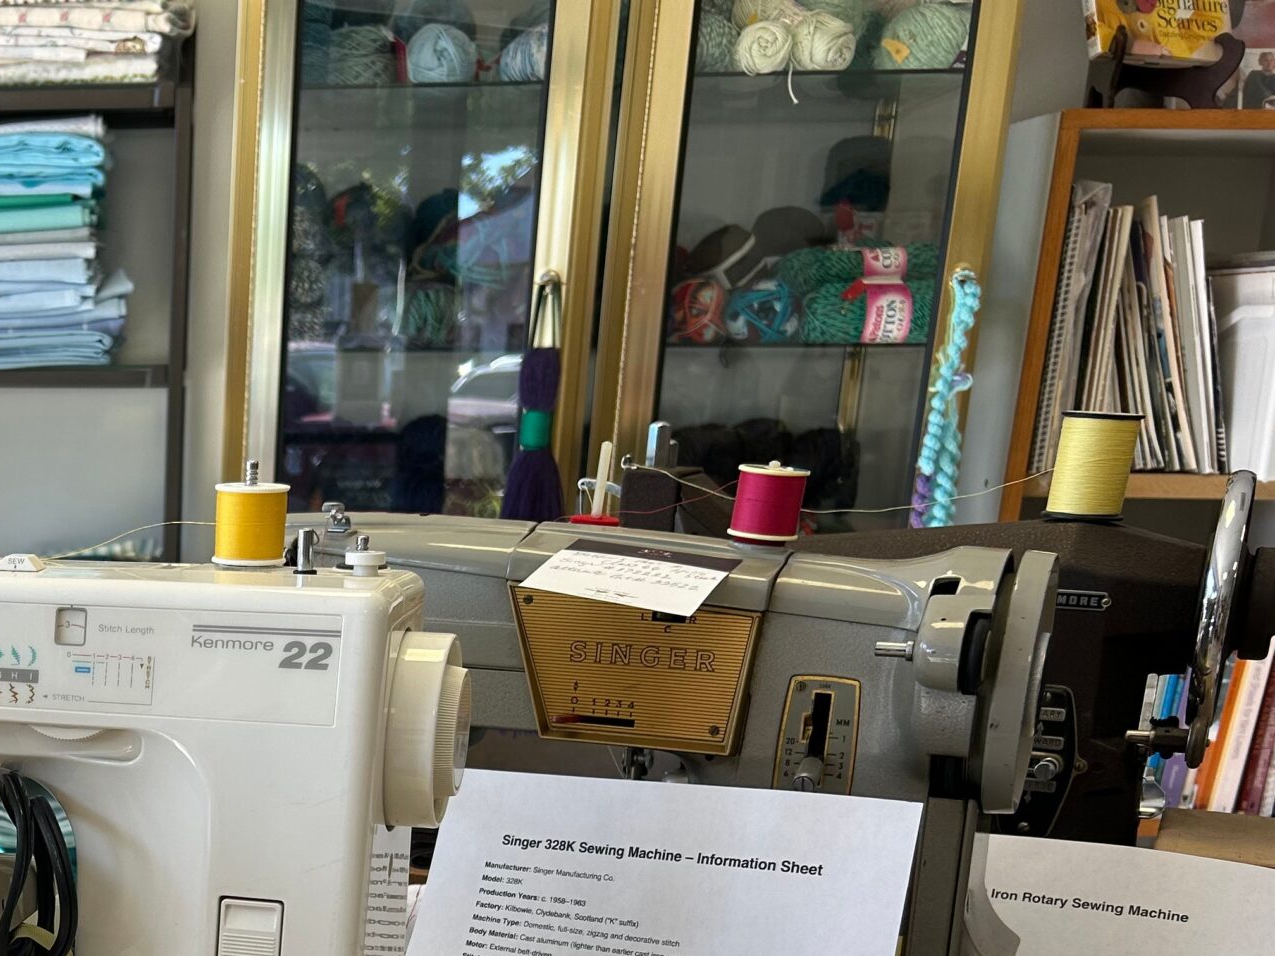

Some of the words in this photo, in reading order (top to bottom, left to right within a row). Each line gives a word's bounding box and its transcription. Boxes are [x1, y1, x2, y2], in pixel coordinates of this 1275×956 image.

[1157, 9, 1218, 32] Scarves
[97, 624, 123, 633] Stitch
[125, 625, 155, 636] Length
[191, 636, 275, 651] Kenmore
[278, 640, 333, 670] 22
[569, 640, 715, 672] SINGER
[52, 694, 85, 702] STRETCH
[501, 834, 542, 850] Singer
[544, 838, 575, 851] 328K
[578, 841, 624, 859] Sewing
[627, 846, 681, 861] Machine
[697, 852, 776, 870] Information
[780, 860, 823, 875] Sheet
[481, 874, 504, 882] Model:
[484, 861, 531, 872] Manufacturer:
[532, 866, 554, 875] Singer
[555, 868, 601, 881] Manufacturing
[602, 873, 616, 881] Co.
[991, 888, 1017, 900] Iron
[1022, 892, 1067, 908] Rotary
[1071, 898, 1123, 916] Sewing
[1128, 905, 1188, 922] Machine
